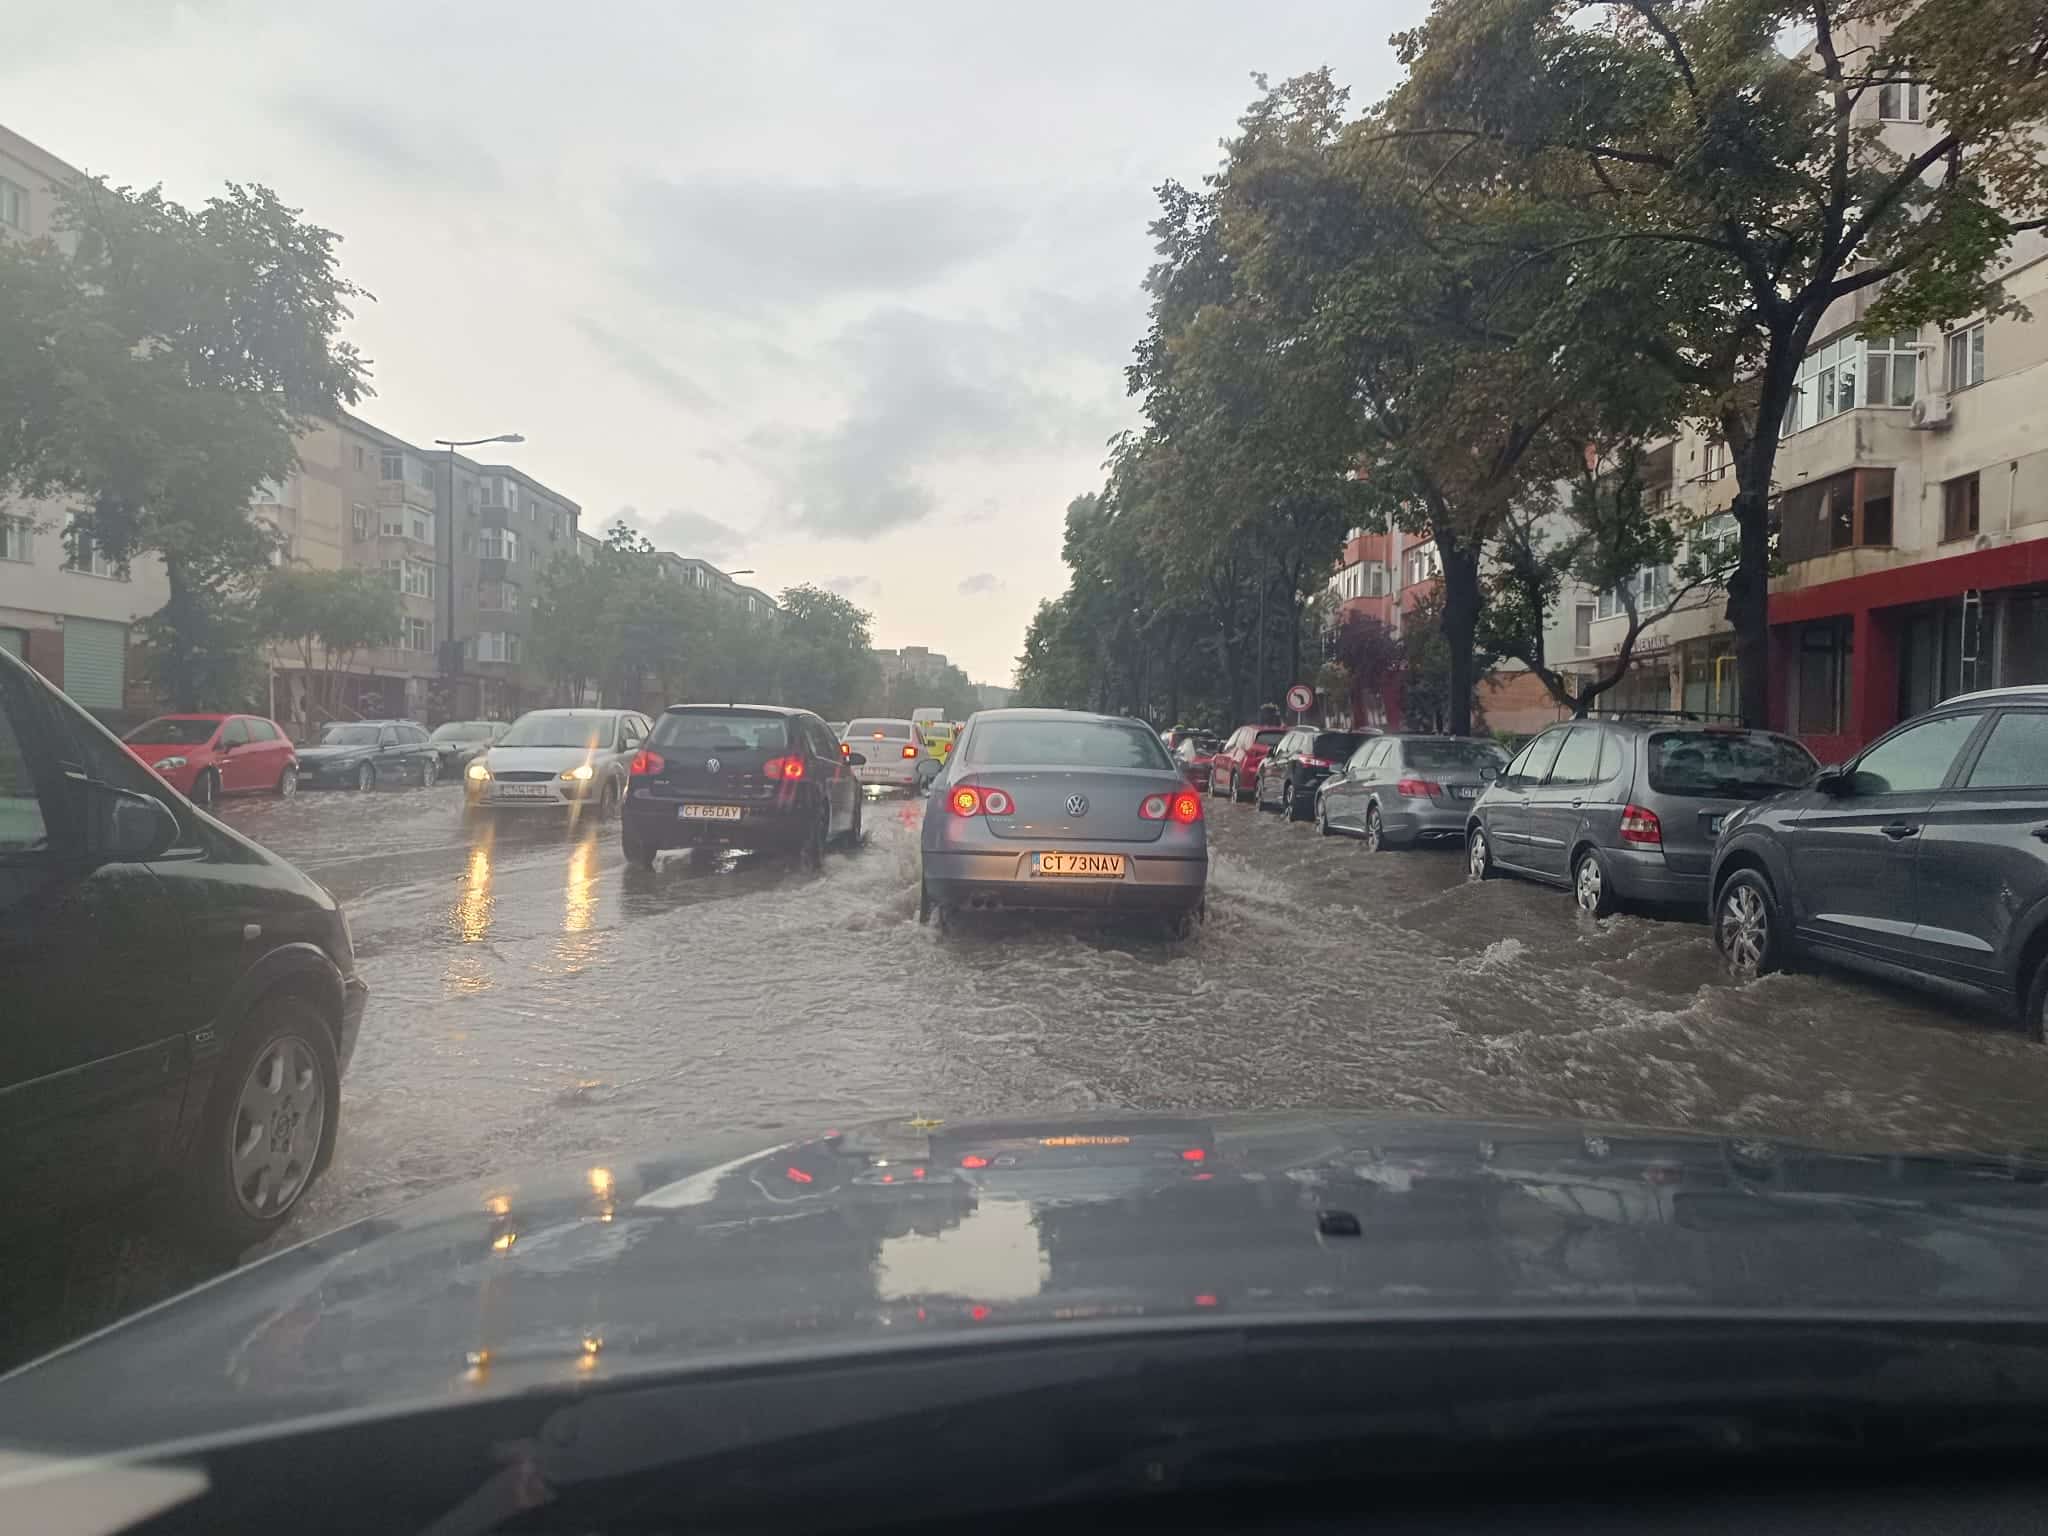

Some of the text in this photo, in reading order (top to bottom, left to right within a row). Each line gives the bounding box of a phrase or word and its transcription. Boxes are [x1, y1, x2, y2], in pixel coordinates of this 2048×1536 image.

[684, 805, 699, 816] CT
[1043, 856, 1120, 871] CT 73NAV
